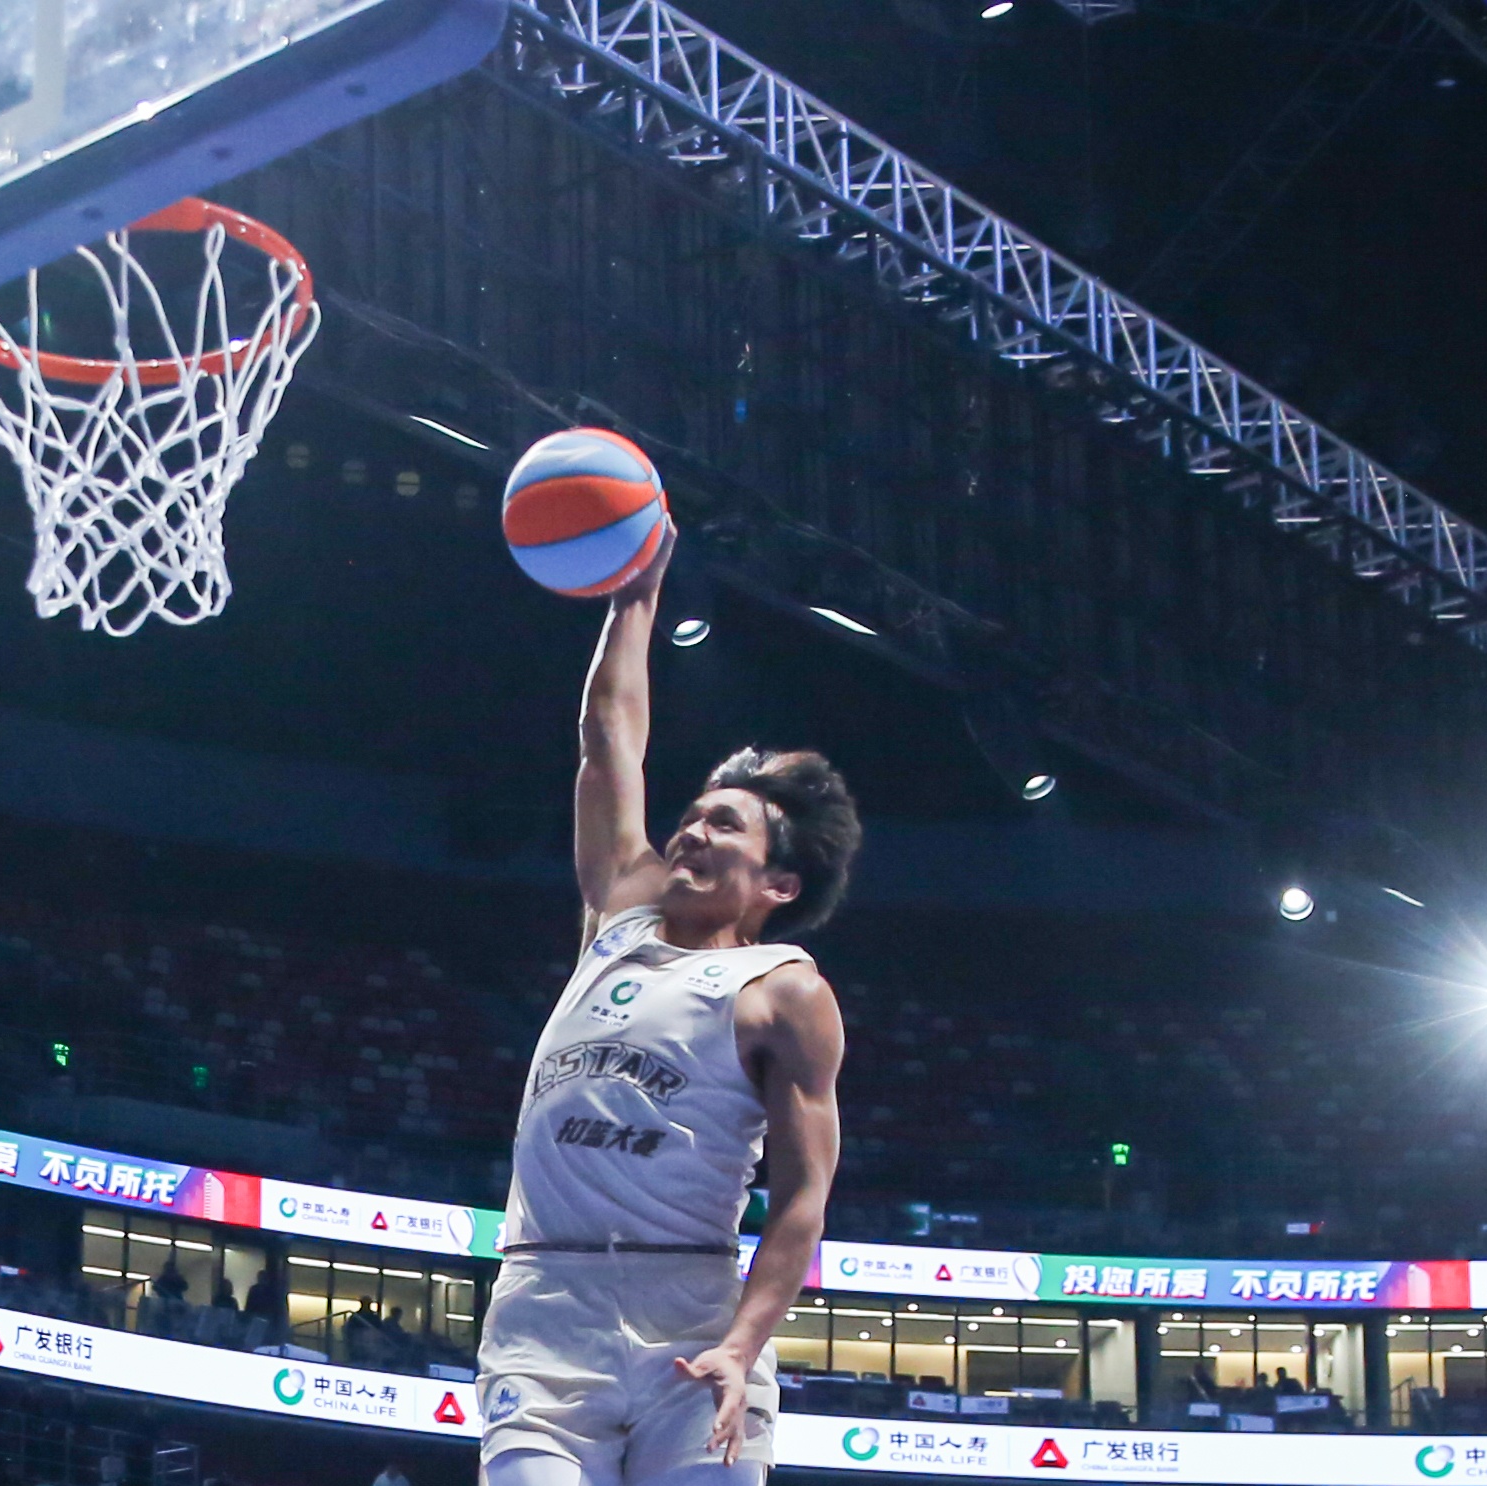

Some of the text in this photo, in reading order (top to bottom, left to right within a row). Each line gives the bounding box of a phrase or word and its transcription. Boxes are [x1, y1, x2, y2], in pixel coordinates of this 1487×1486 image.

[528, 1040, 688, 1107] LSTAR
[39, 1150, 178, 1206] 不负所托
[303, 1202, 351, 1217] 中国人寿
[395, 1215, 443, 1232] 广发银行
[863, 1260, 914, 1272] 中国人寿
[960, 1265, 1009, 1280] 广发银行
[1063, 1264, 1378, 1302] 投您所爱 不负所托
[15, 1324, 93, 1360] 广发银行
[314, 1375, 399, 1405] 中国人寿
[313, 1397, 398, 1418] CHINA LIFE
[889, 1431, 989, 1455] 中国人寿
[1082, 1440, 1179, 1462] 广发银行
[889, 1451, 988, 1466] CHINA LIFE
